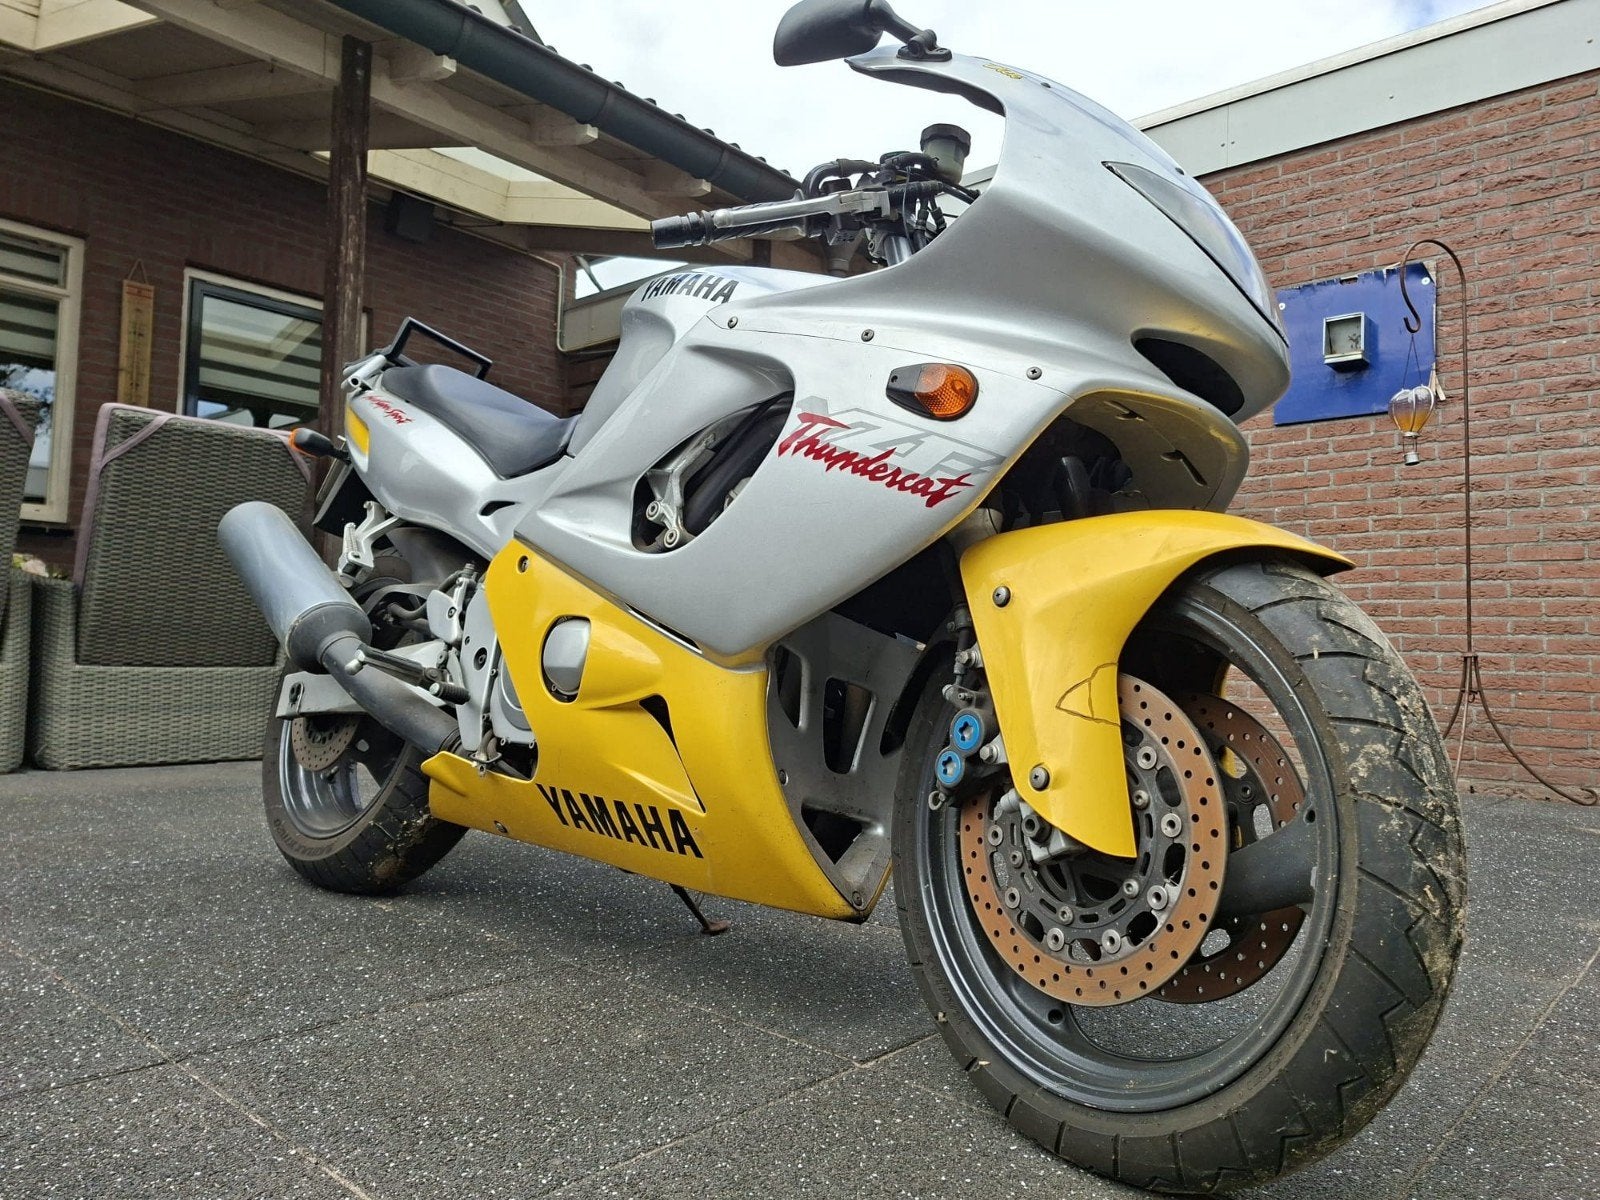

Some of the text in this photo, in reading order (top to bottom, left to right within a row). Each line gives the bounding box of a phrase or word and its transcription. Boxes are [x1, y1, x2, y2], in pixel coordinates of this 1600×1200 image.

[641, 272, 739, 303] YAMAHA
[778, 411, 976, 508] Thundercat
[535, 783, 704, 859] YAMAHA
